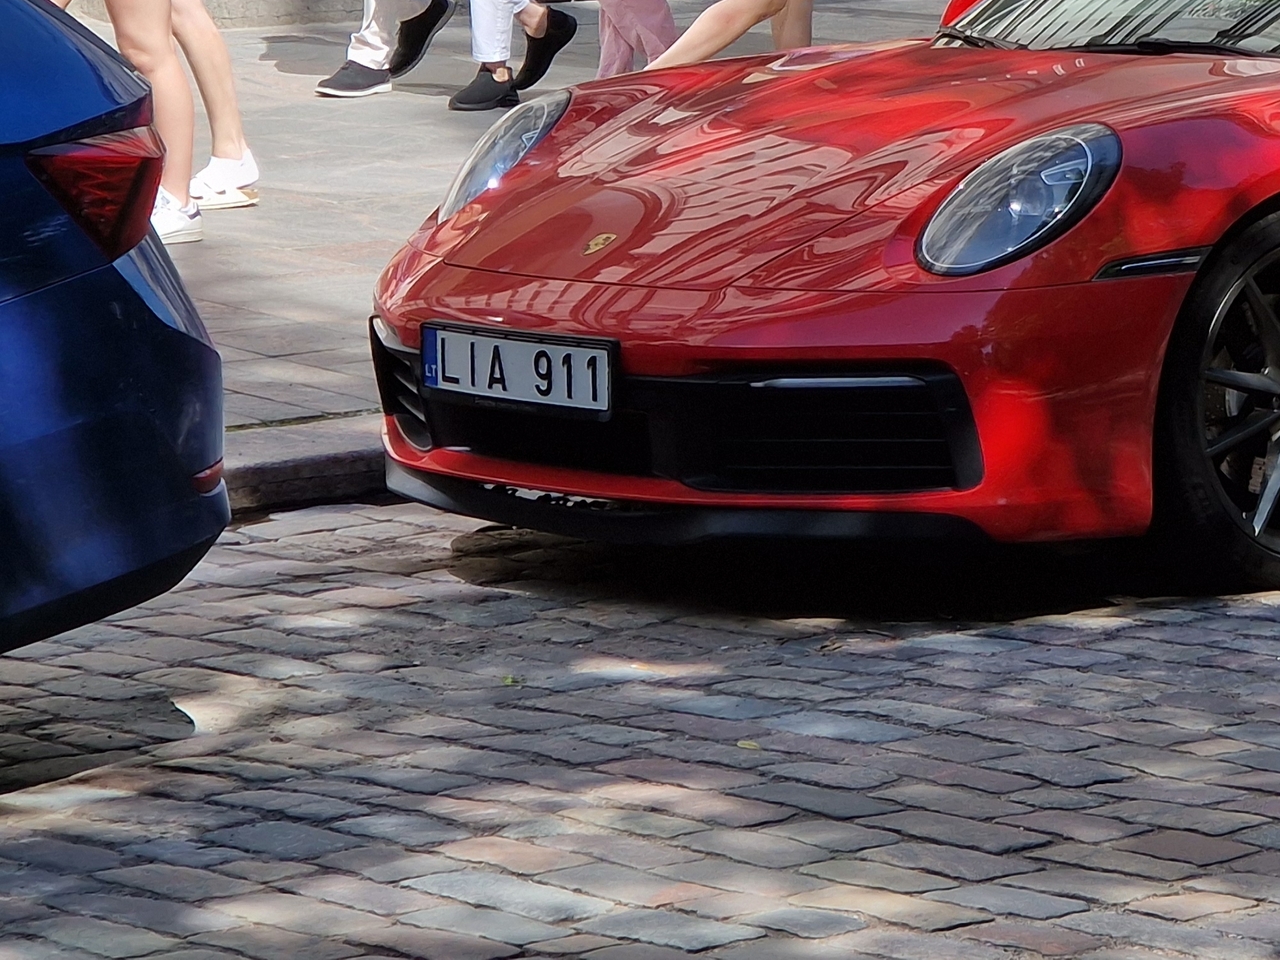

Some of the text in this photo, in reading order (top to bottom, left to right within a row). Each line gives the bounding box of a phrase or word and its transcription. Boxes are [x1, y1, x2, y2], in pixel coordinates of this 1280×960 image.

[425, 363, 437, 378] LT
[440, 337, 598, 403] LIA 911
